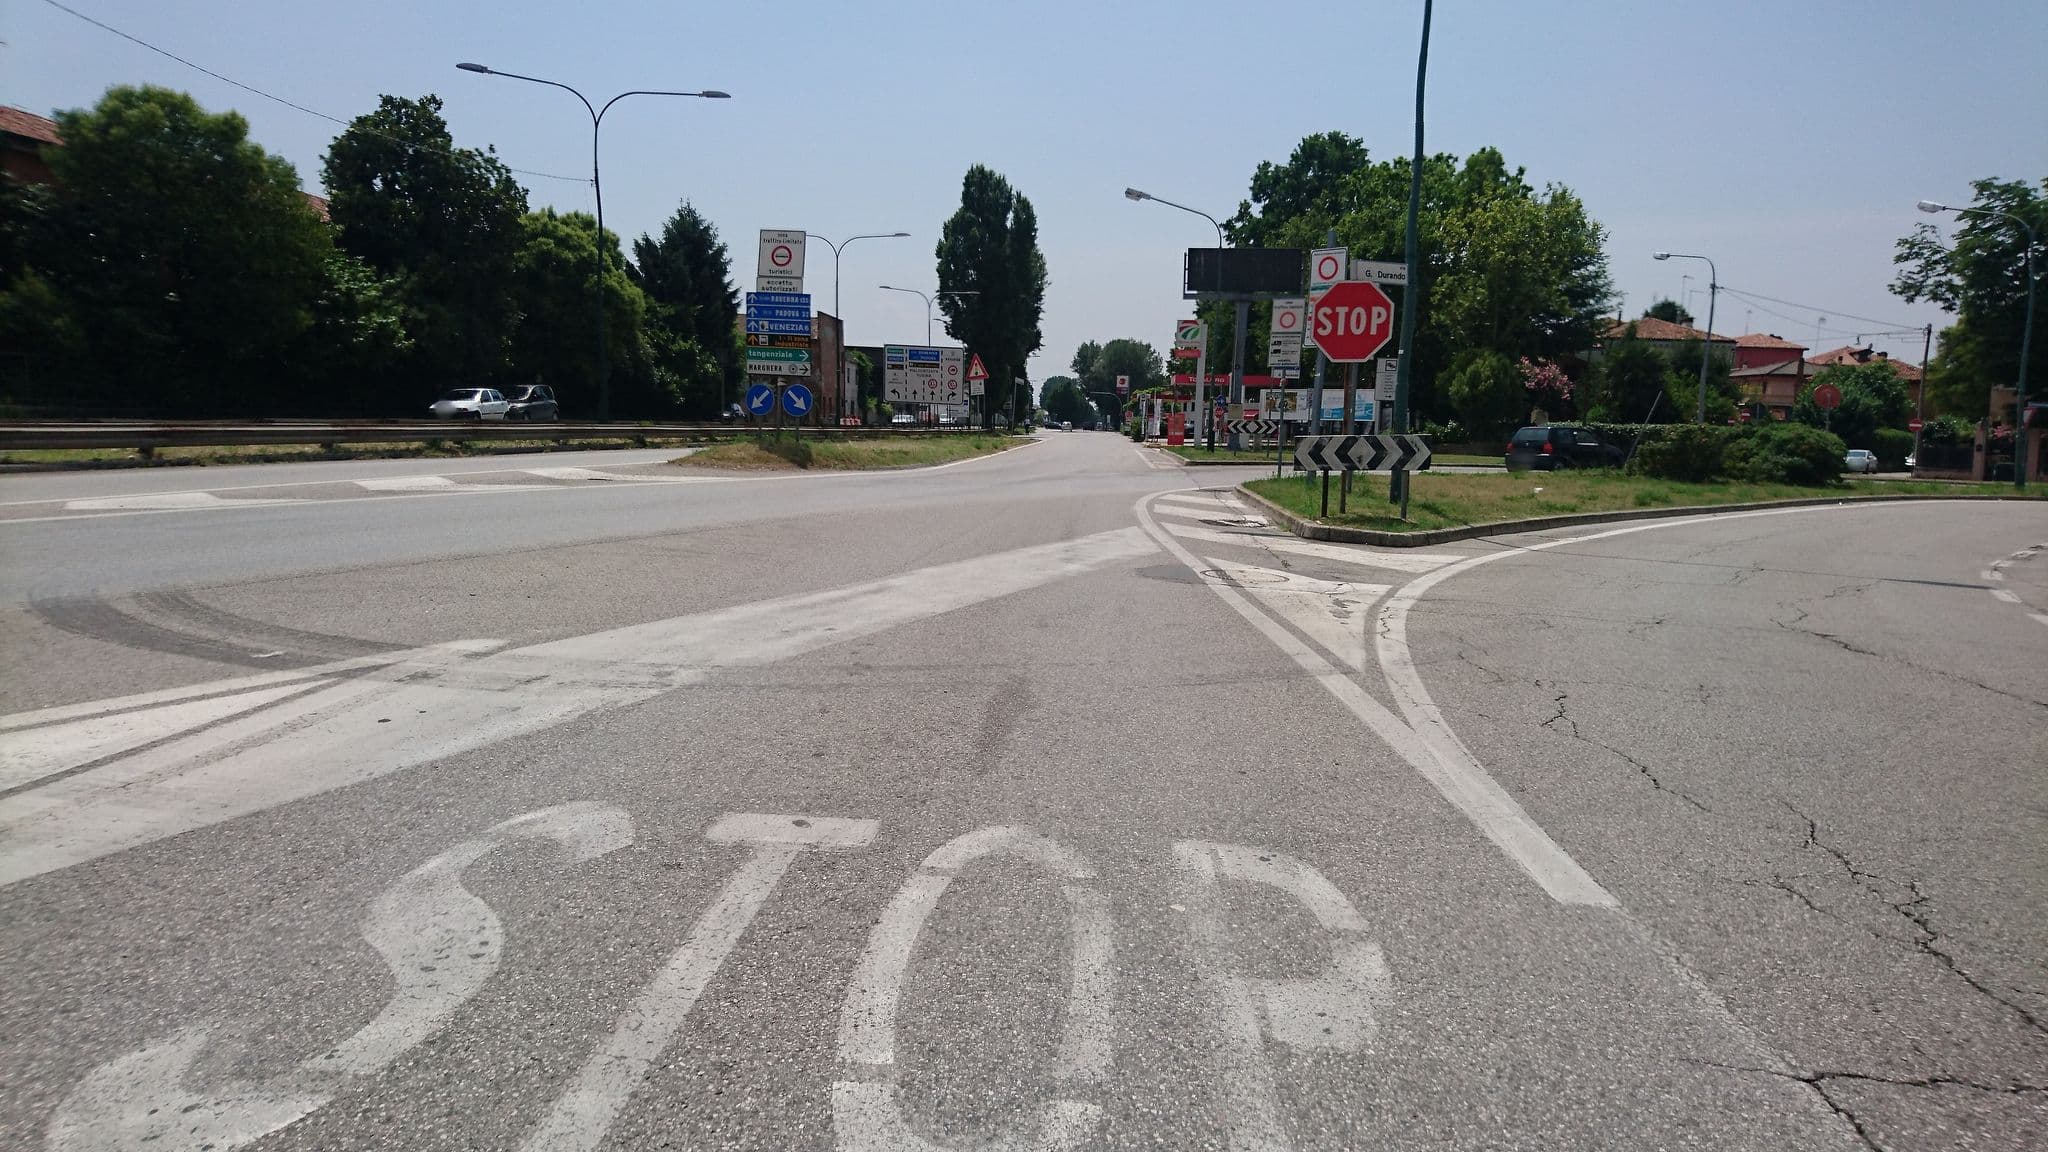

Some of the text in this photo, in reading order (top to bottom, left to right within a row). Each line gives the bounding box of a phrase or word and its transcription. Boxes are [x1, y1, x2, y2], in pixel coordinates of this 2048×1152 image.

[1365, 270, 1406, 280] G. Durando
[1317, 306, 1387, 336] STOP
[770, 323, 804, 331] VENEZIA
[748, 350, 792, 358] tangenziale
[748, 364, 782, 372] MARGHERA
[45, 799, 1393, 1152] STOP
